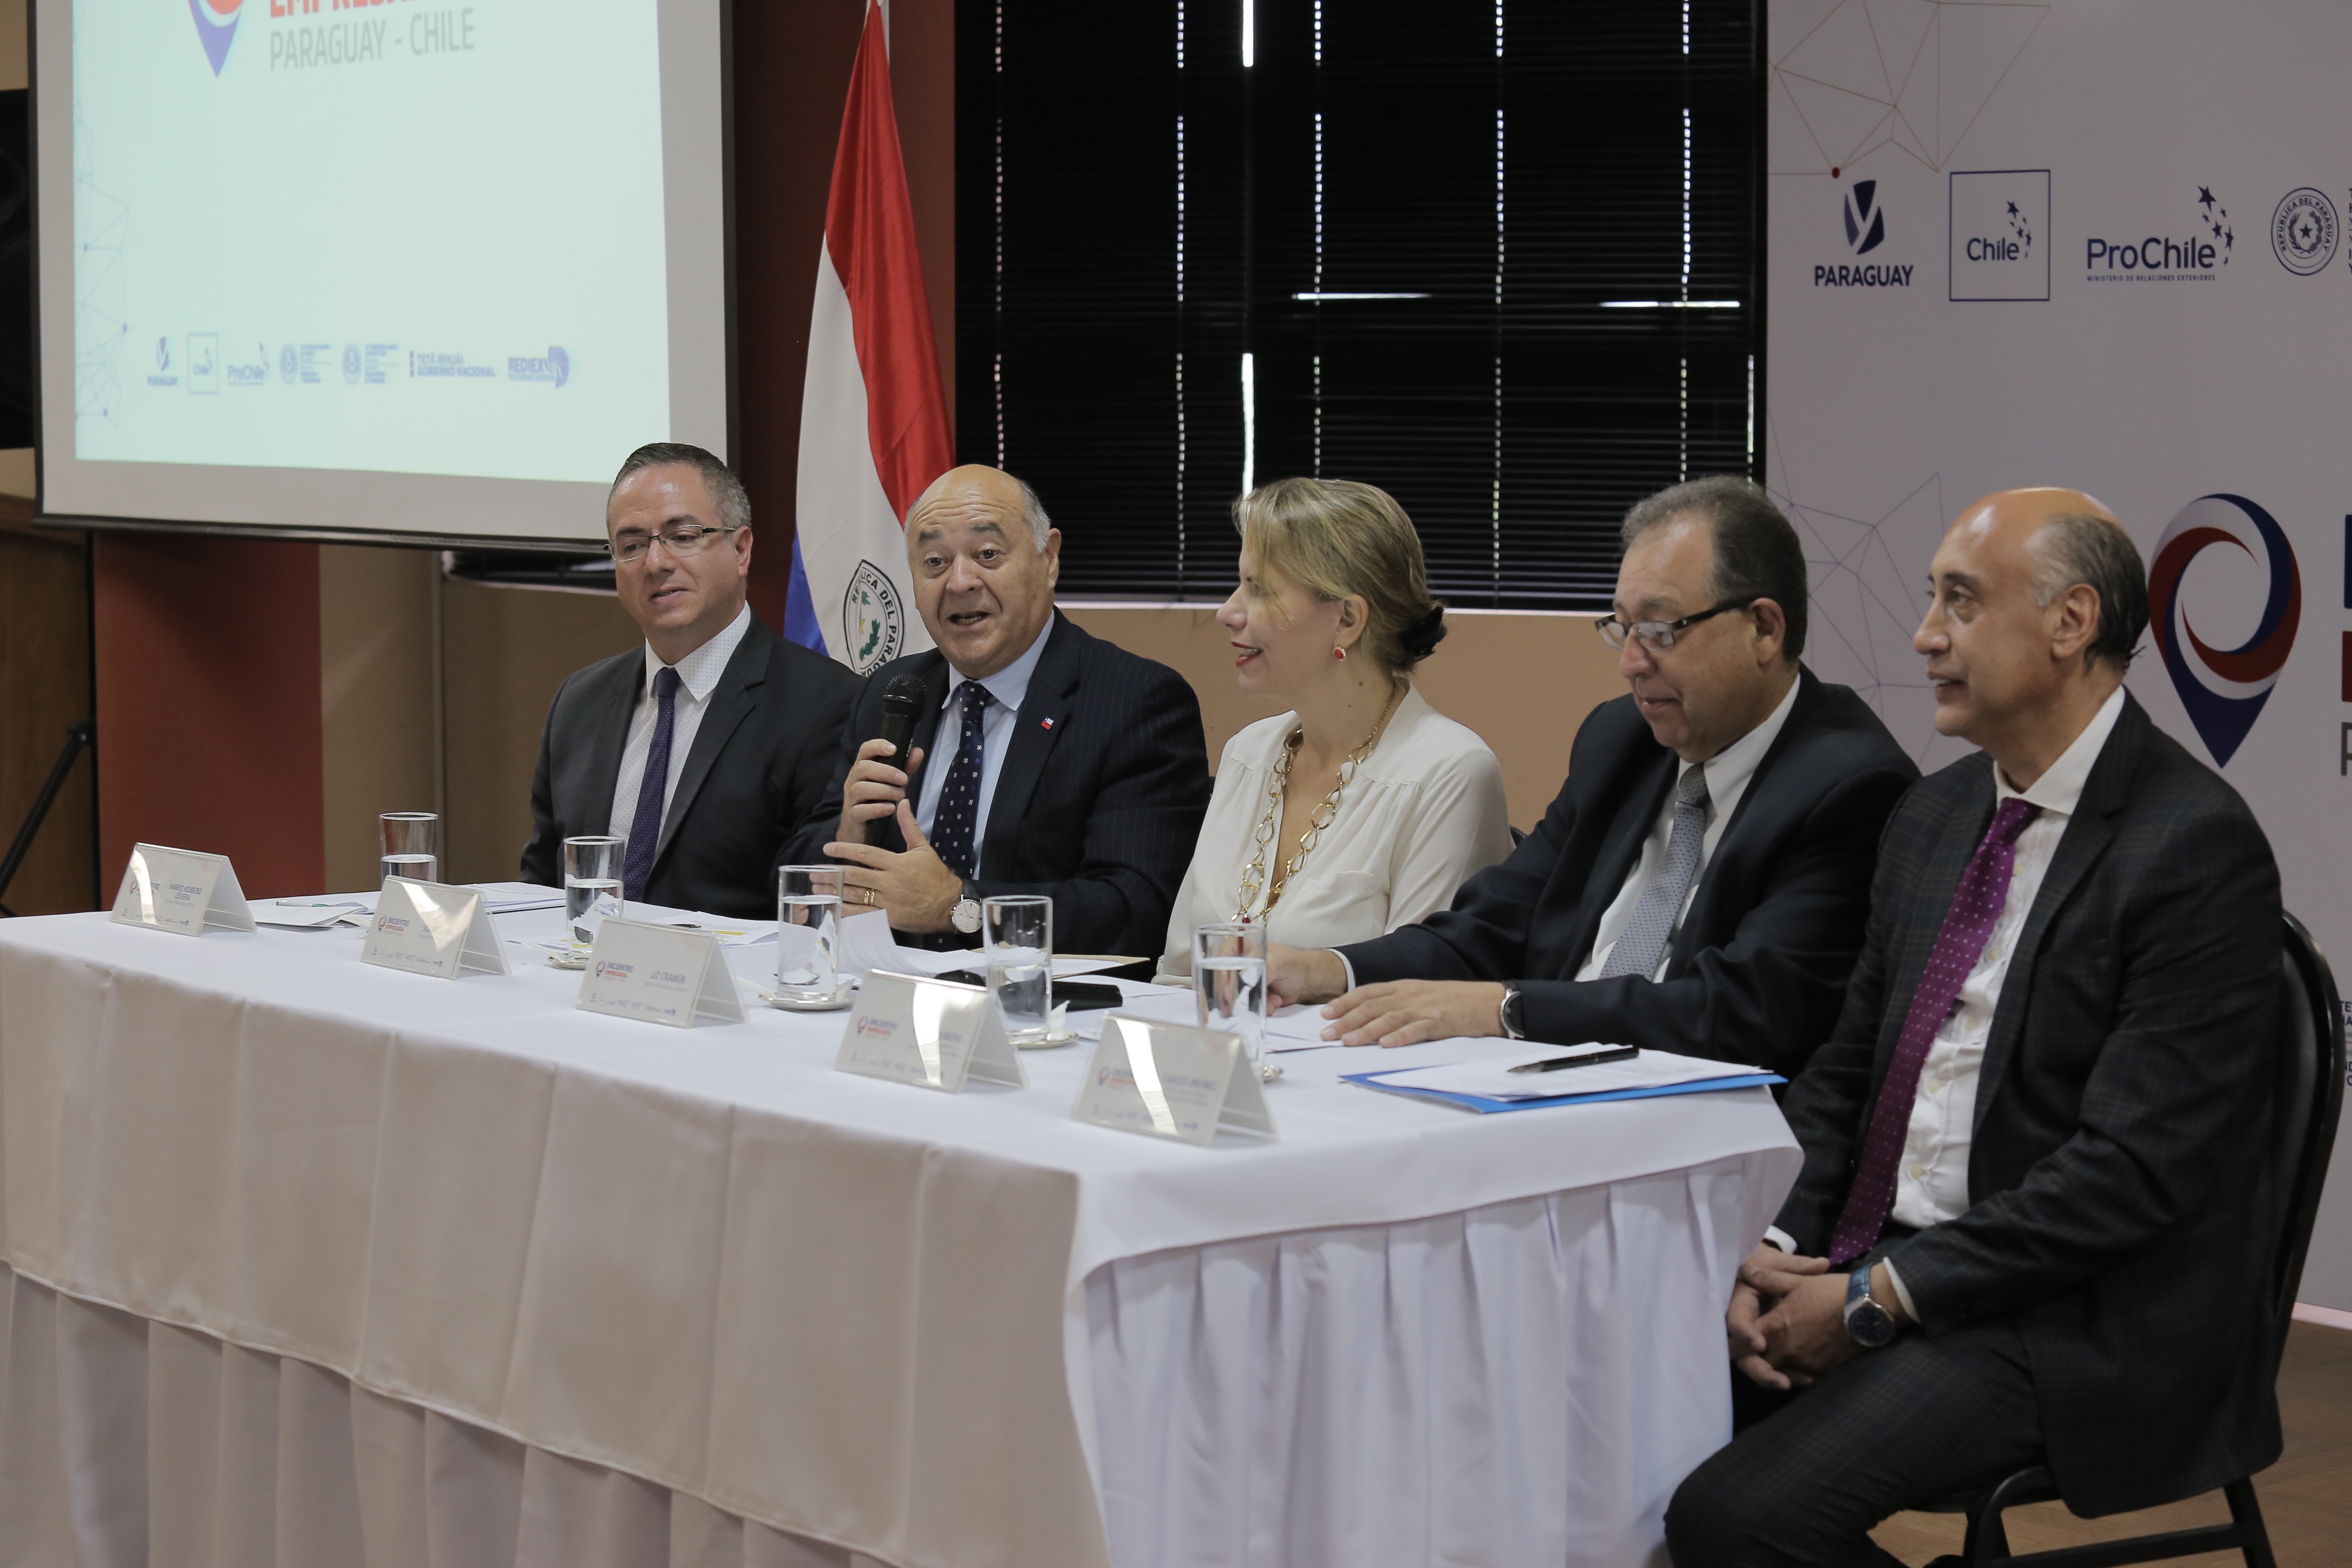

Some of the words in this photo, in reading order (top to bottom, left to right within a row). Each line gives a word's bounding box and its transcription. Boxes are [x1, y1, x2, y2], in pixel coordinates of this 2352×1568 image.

[270, 18, 386, 70] PARAGUAY
[410, 8, 474, 56] CHILE
[1967, 238, 2019, 261] Chile
[2087, 237, 2216, 270] ProChile
[1814, 265, 1914, 286] PARAGUAY
[227, 364, 264, 380] ProChile
[879, 589, 895, 619] DEL
